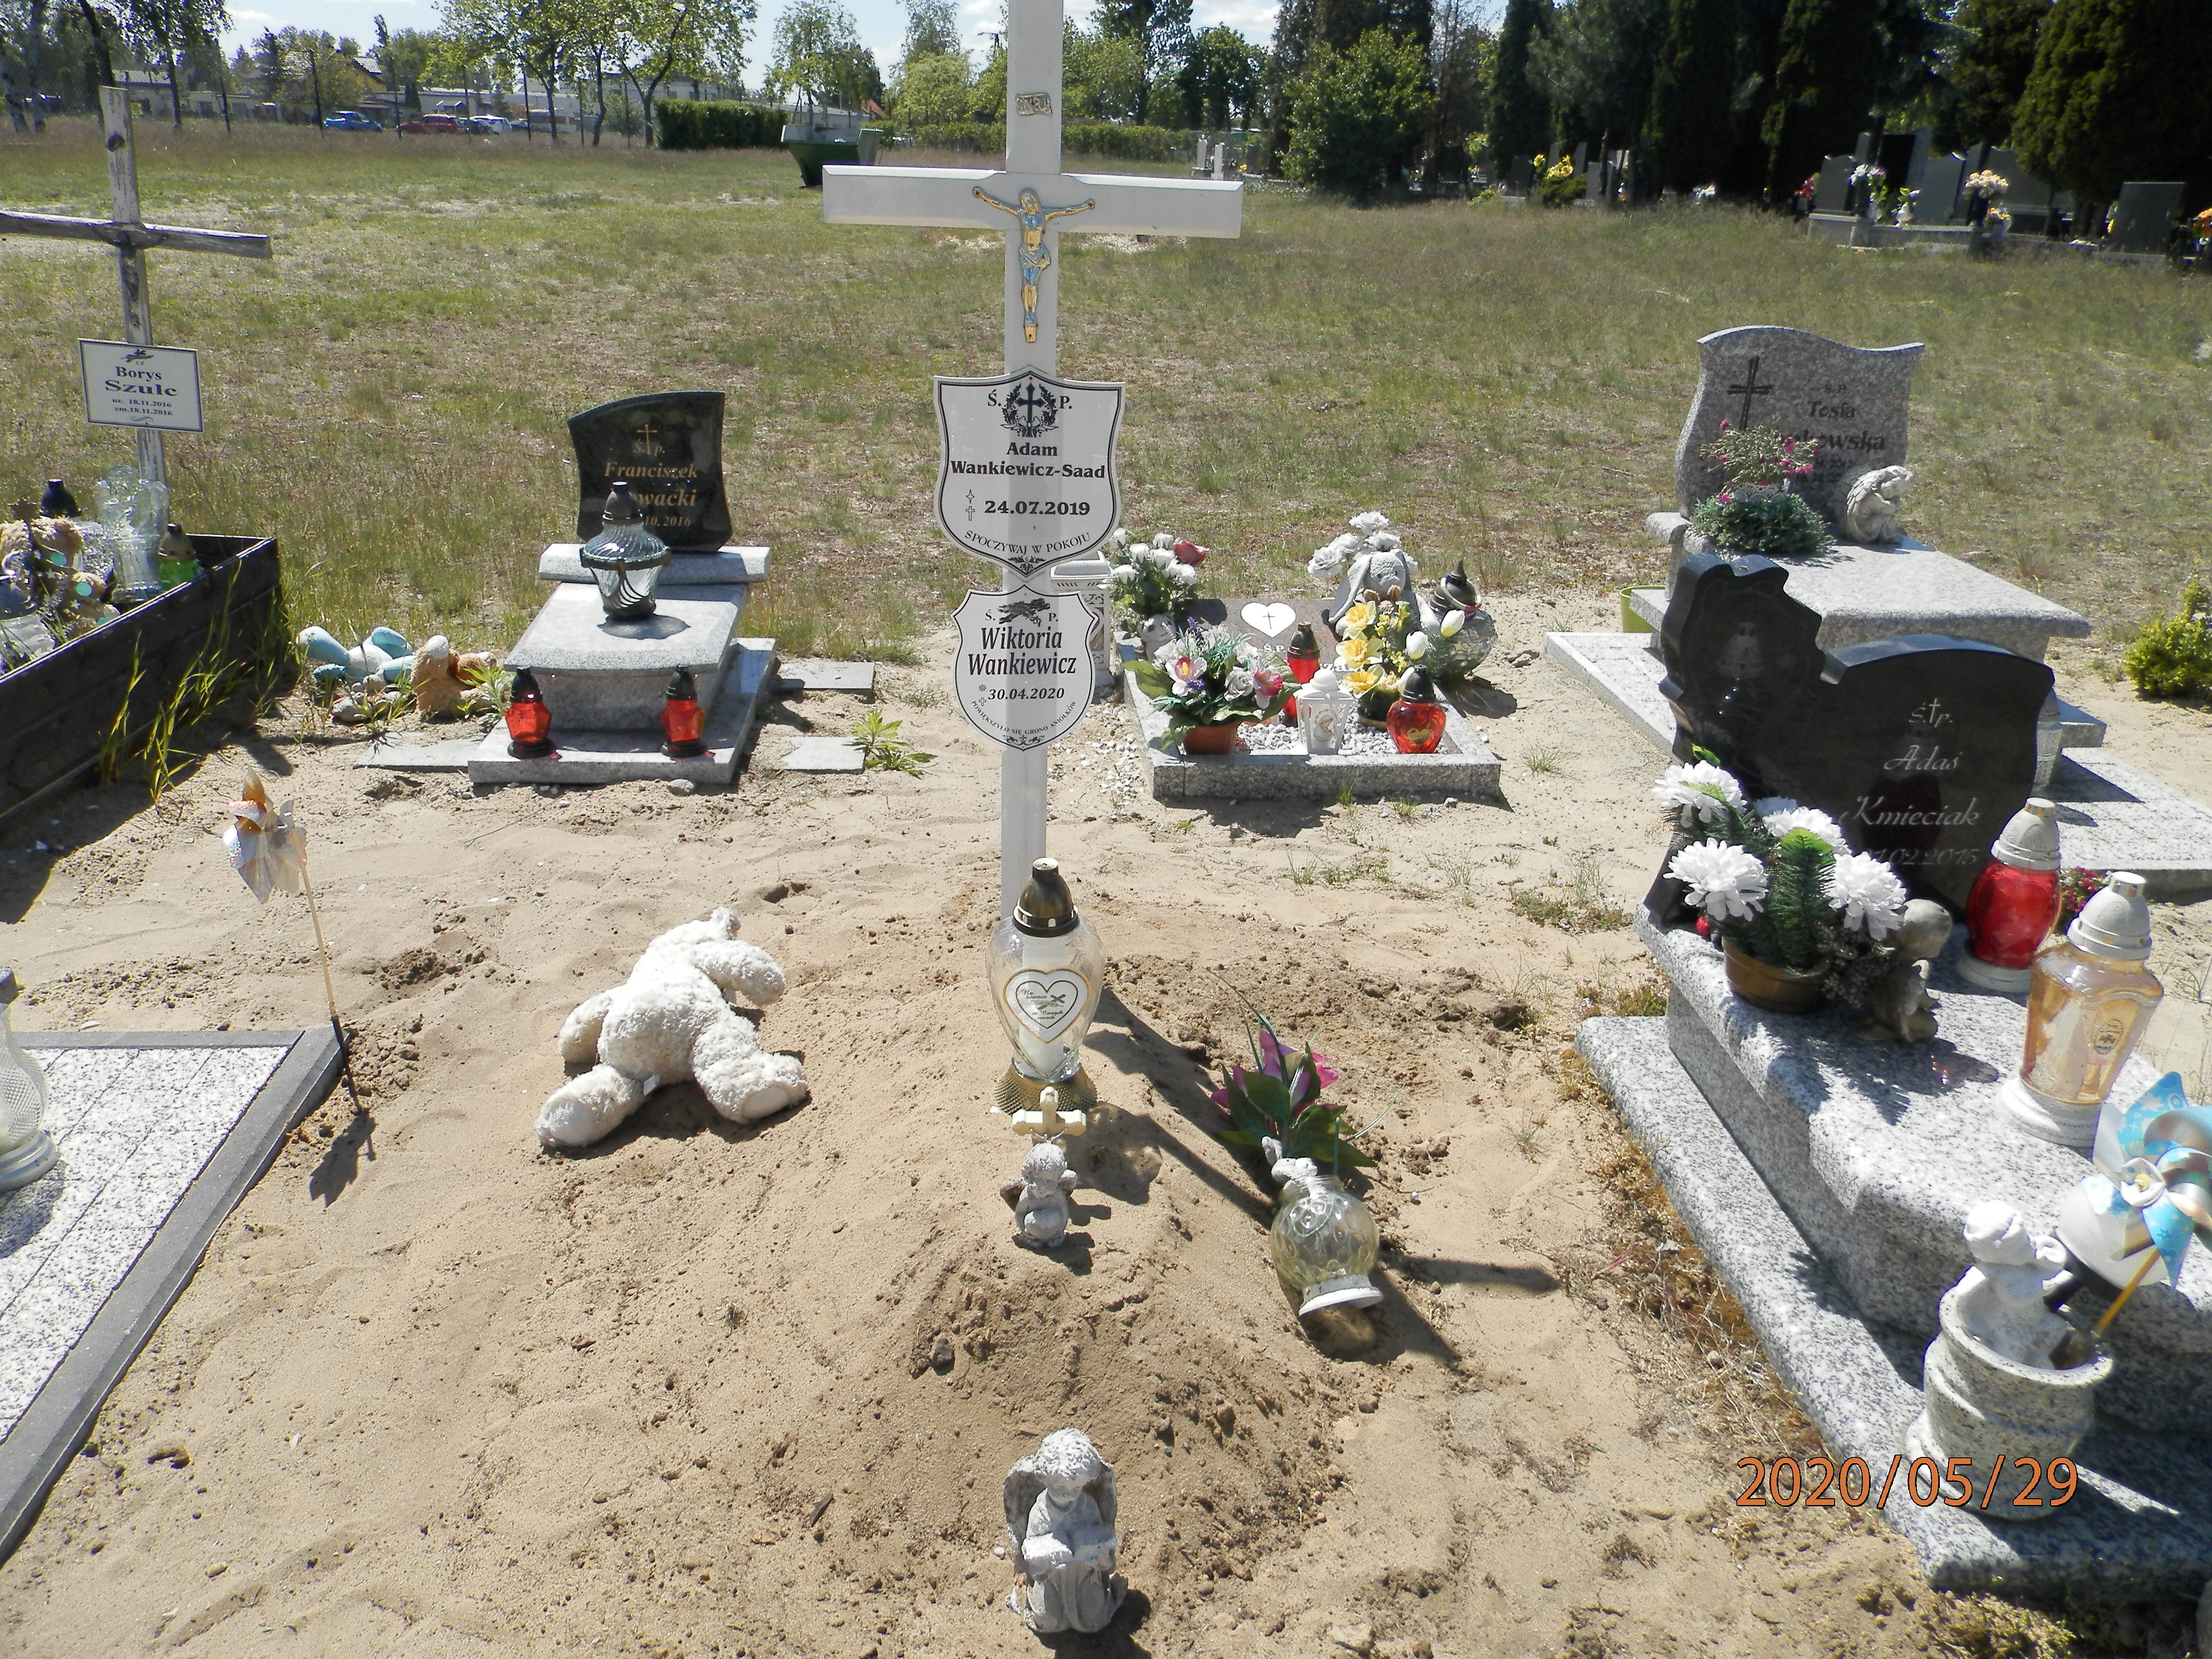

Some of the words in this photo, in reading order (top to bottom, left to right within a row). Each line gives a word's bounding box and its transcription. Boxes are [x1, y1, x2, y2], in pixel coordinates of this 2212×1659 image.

[115, 366, 162, 382] Borys
[105, 380, 177, 396] Szulc
[987, 389, 1001, 407] Ś.
[1059, 396, 1072, 409] P.
[1807, 401, 1855, 418] Tosia
[1006, 442, 1058, 457] Adam
[603, 461, 698, 479] Franciszek
[951, 460, 1105, 479] Wankiewicz-Saad
[985, 500, 1090, 516] 24.07.2019
[964, 530, 1027, 555] SPOCZYWAJ
[1032, 545, 1042, 554] W
[1046, 533, 1091, 553] POKOJU
[986, 609, 996, 621] Ś.
[1048, 613, 1058, 622] P.
[981, 626, 1062, 649] Wiktoria
[968, 652, 1077, 675] Wankiewicz
[988, 688, 1065, 700] 30.04.2020
[972, 700, 1009, 733] POWIĘKSZYŁO
[1025, 725, 1048, 735] GRONO
[1051, 700, 1076, 729] ANIOŁKÓW
[1883, 745, 1962, 770] Adaś
[1838, 796, 1980, 826] Kmieciak
